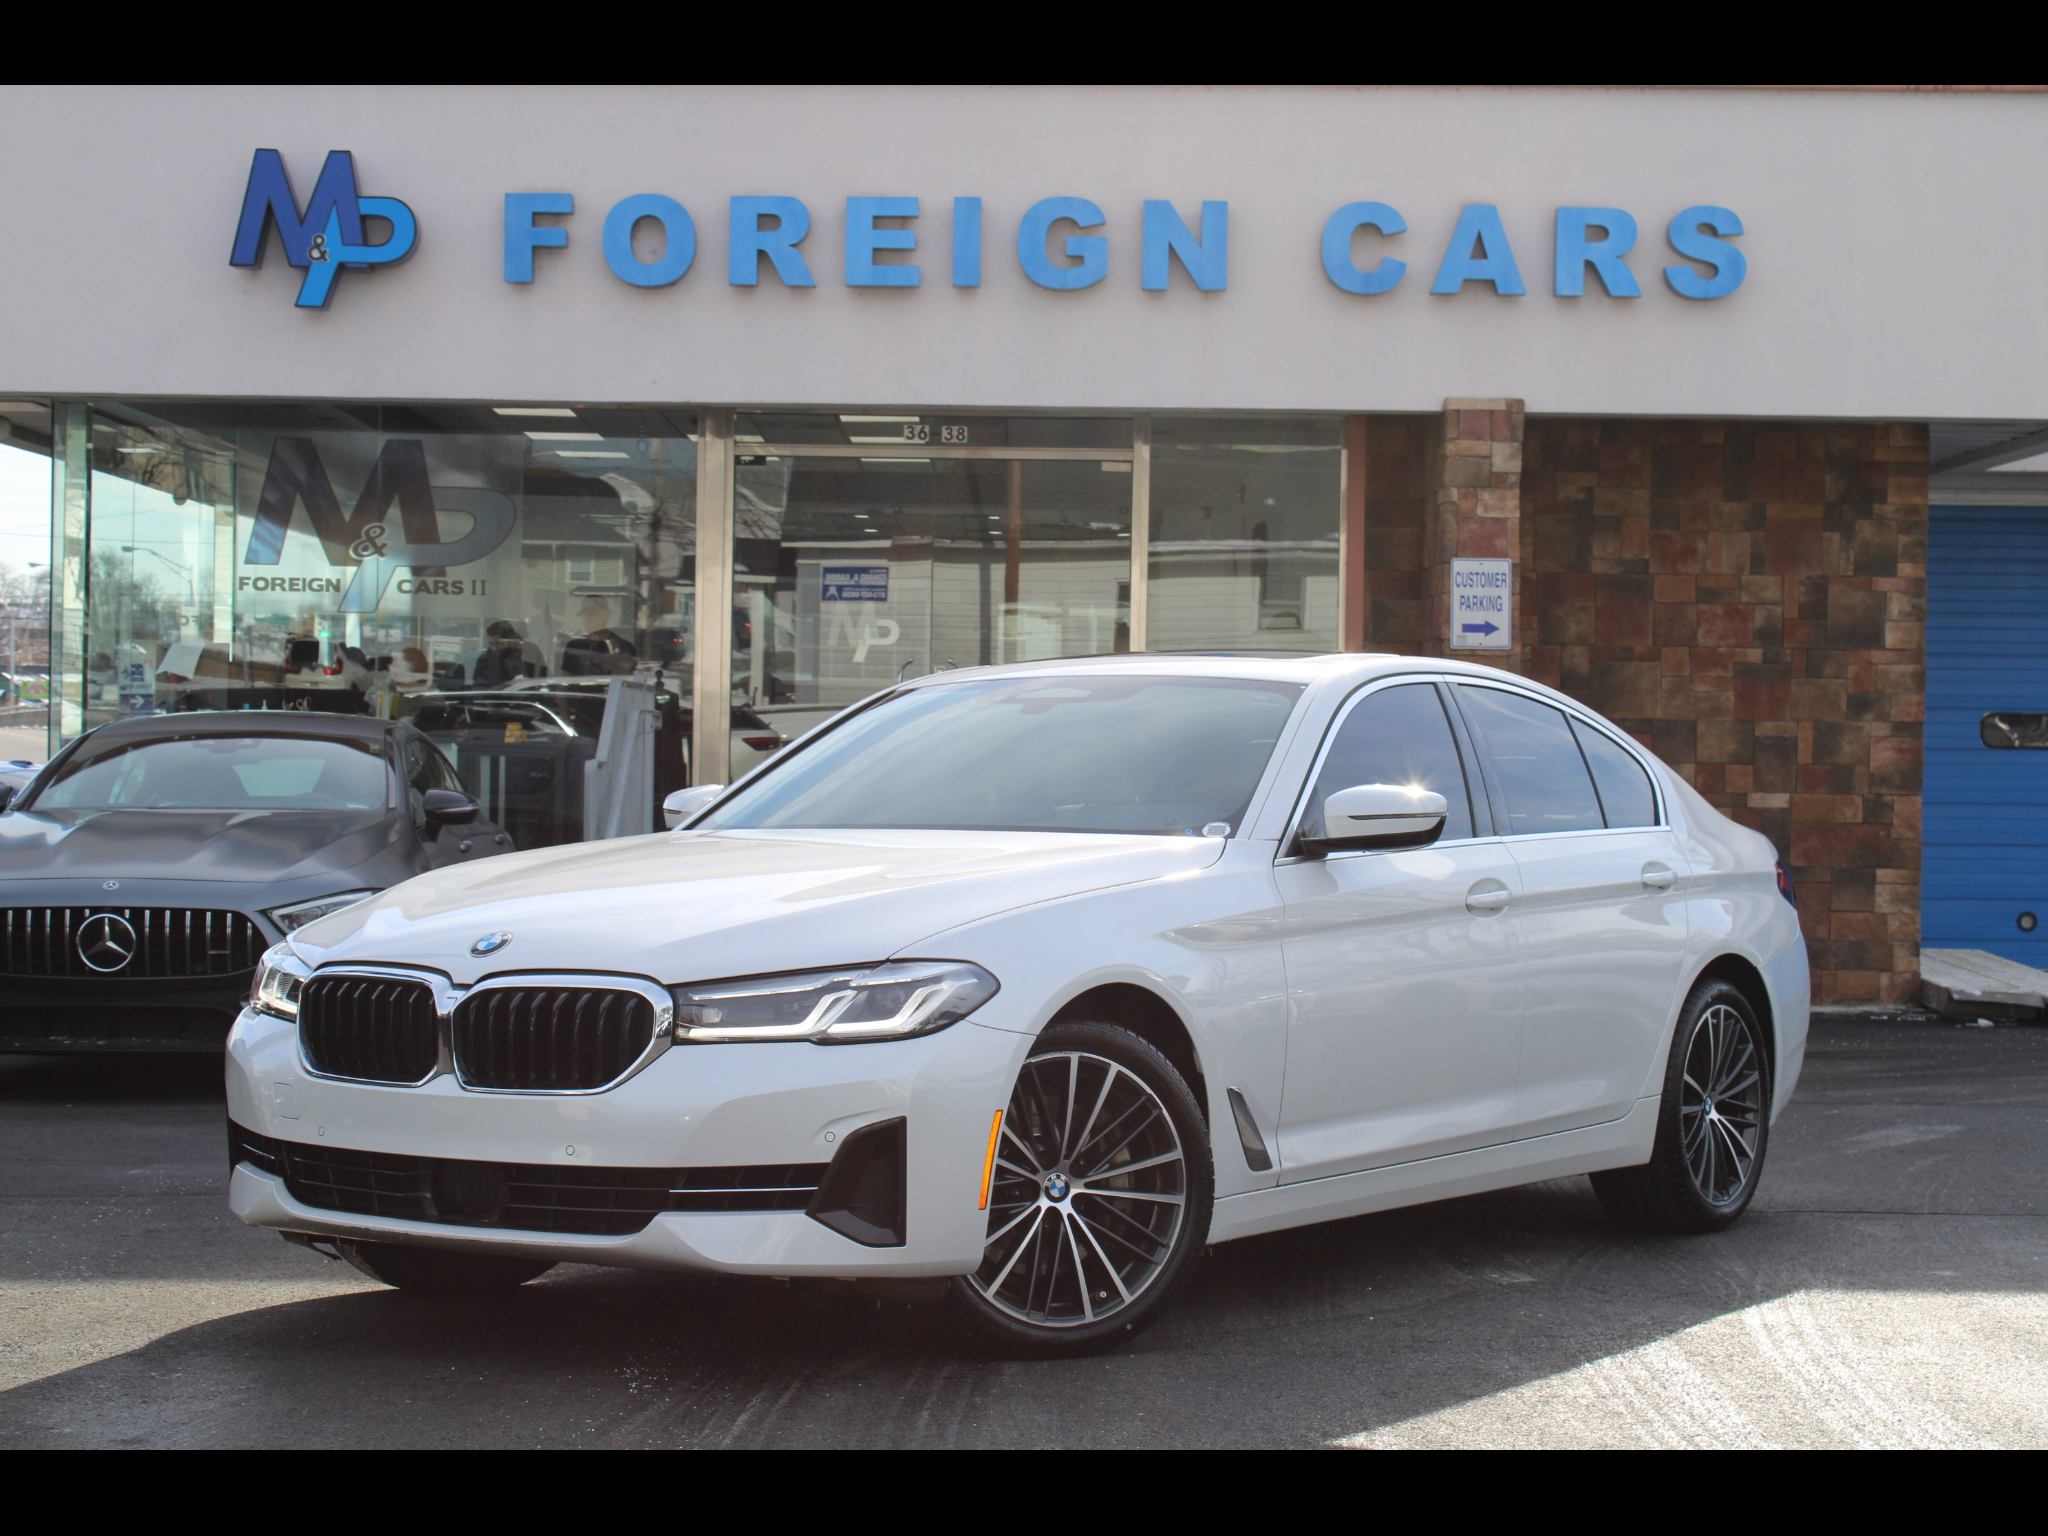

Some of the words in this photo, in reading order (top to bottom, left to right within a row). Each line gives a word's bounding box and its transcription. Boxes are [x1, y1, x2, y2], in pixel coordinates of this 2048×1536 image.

[504, 193, 1229, 291] FOREIGN
[1321, 201, 1748, 300] CARS
[238, 577, 342, 593] FOREIGN
[397, 579, 464, 595] CARS
[1455, 571, 1507, 588] CUSTOMER
[1459, 595, 1503, 612] PARKING
